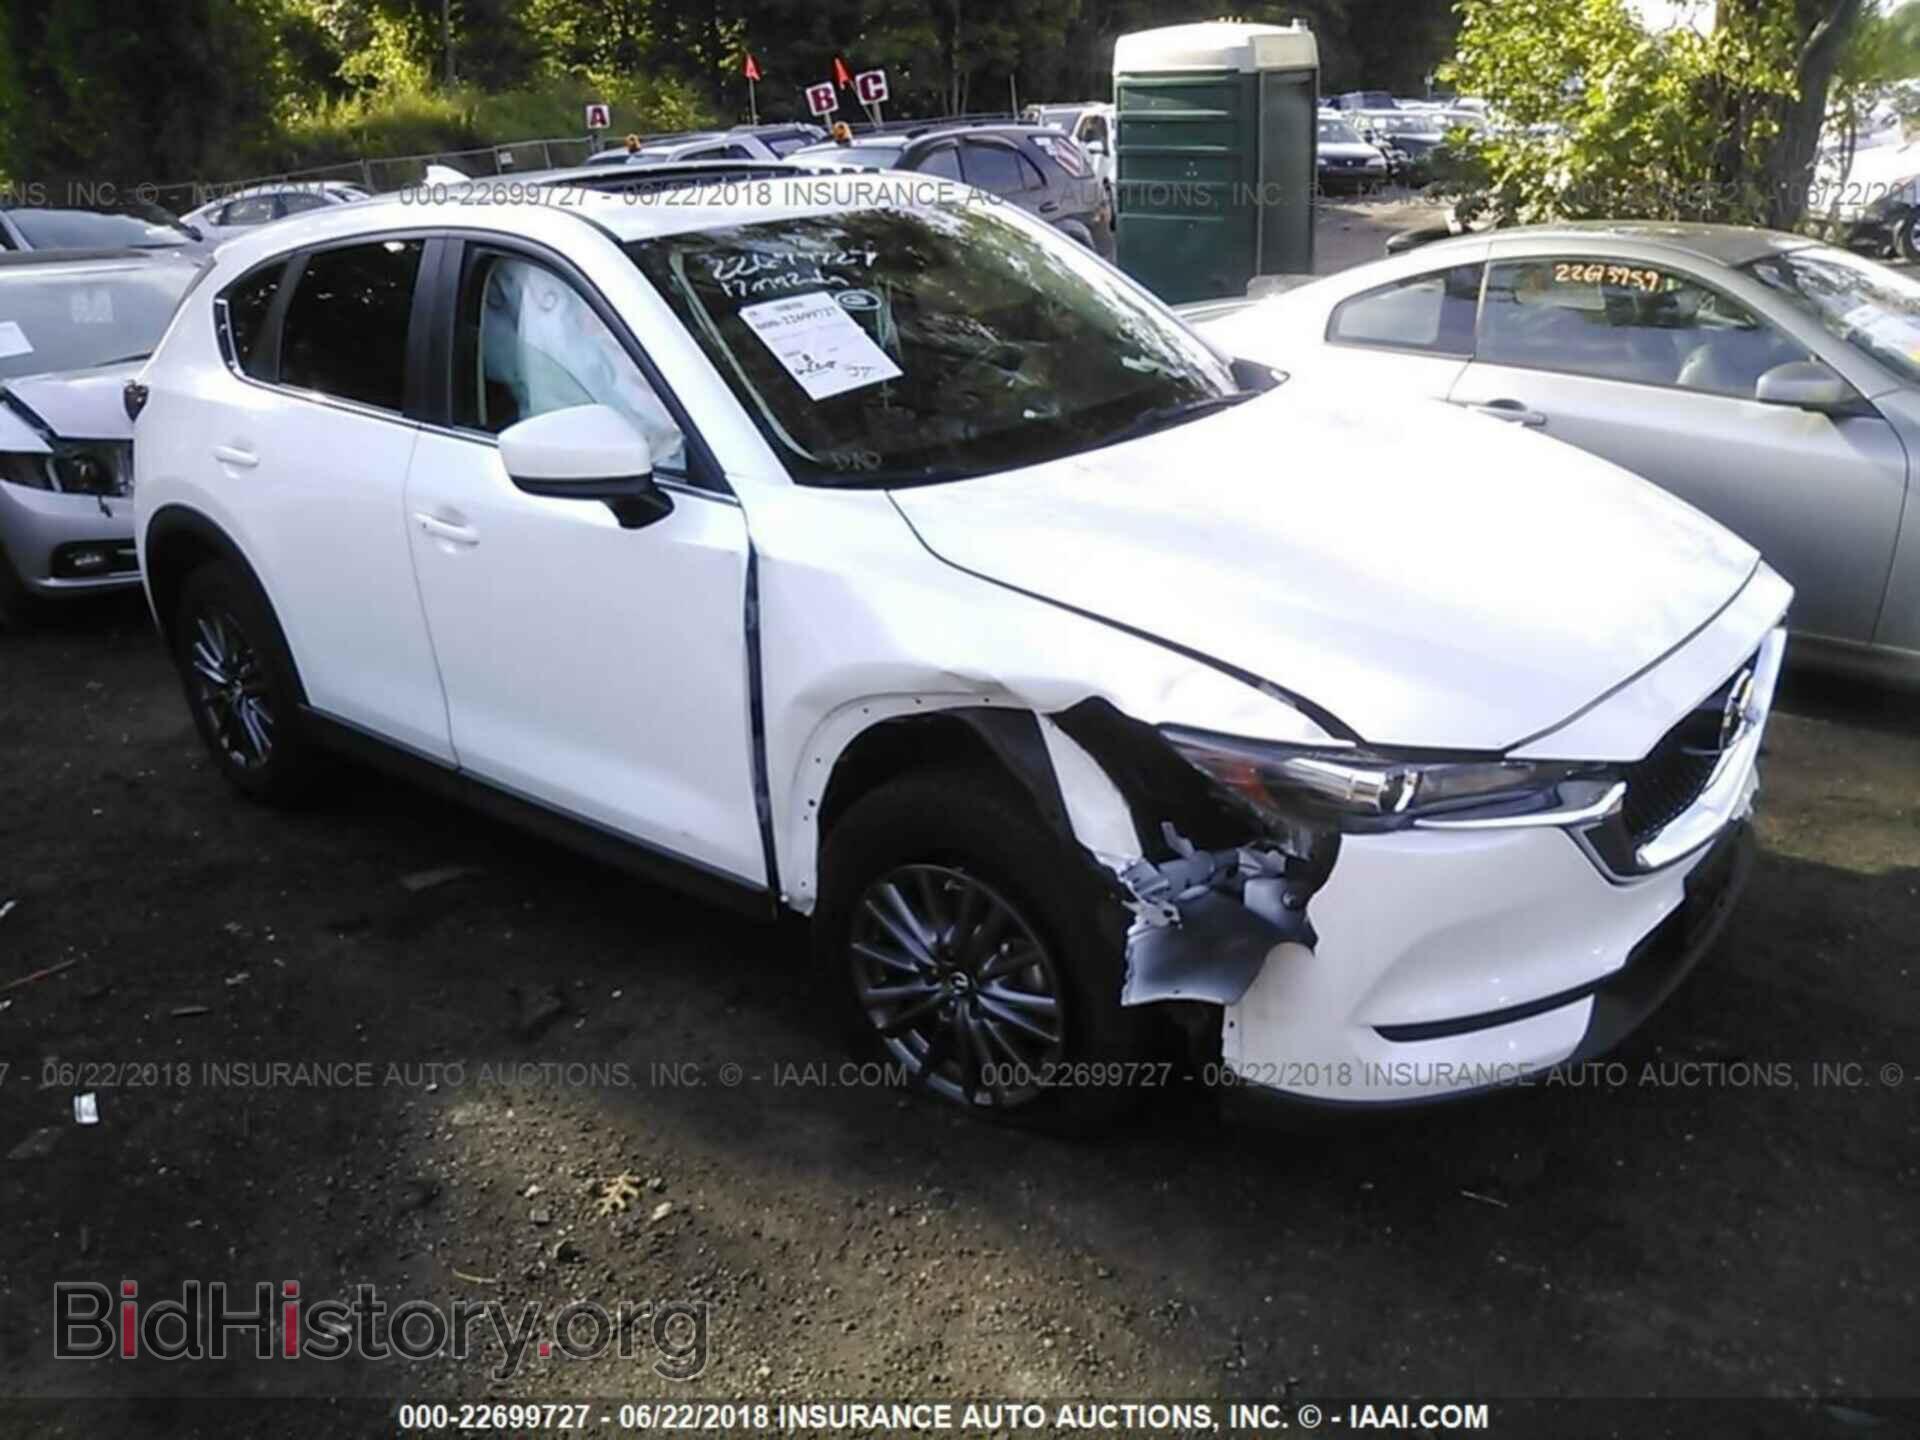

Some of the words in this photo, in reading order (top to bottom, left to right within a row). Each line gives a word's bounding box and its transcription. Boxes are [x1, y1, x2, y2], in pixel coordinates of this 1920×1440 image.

[810, 85, 835, 112] B
[858, 73, 885, 101] C
[590, 107, 607, 126] A
